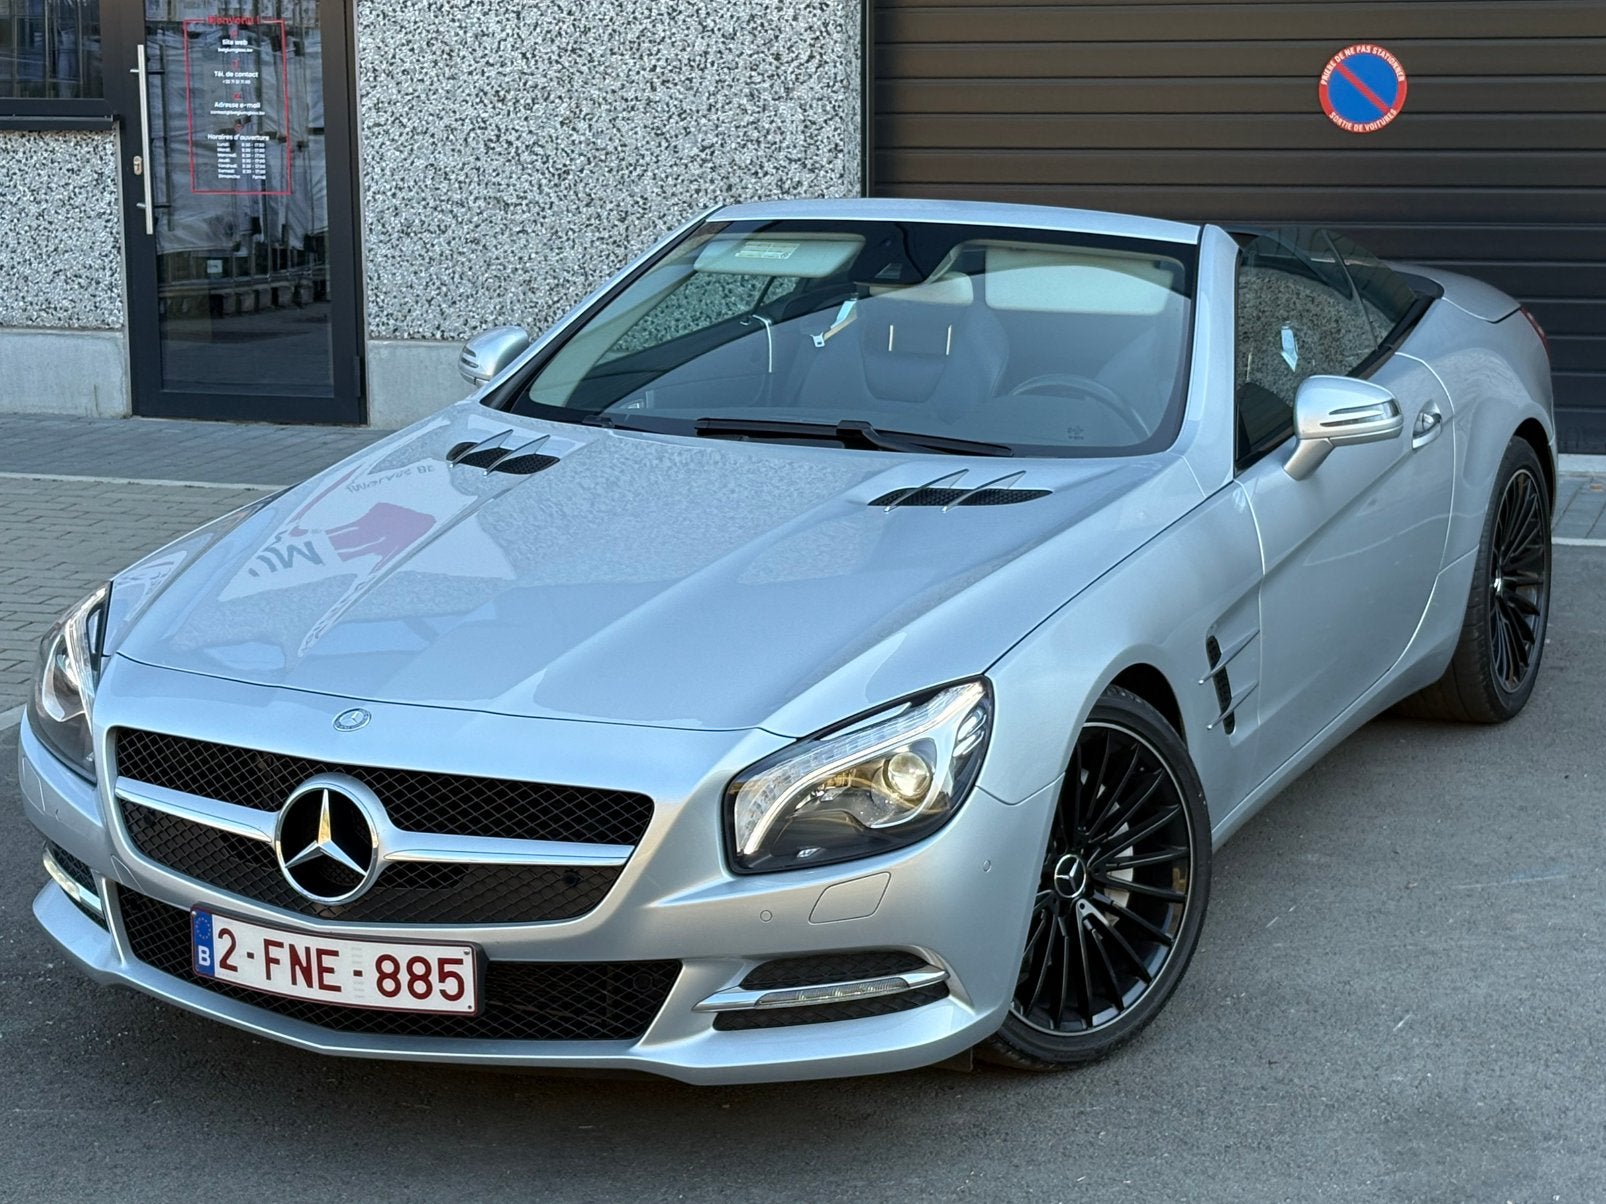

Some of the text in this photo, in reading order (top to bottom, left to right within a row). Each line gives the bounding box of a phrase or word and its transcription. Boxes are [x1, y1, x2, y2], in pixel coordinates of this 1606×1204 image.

[1335, 52, 1345, 63] DE
[1344, 46, 1355, 57] NE
[1356, 45, 1371, 54] PAS
[1372, 46, 1405, 82] STATIONNER
[214, 101, 239, 109] Adresse
[1329, 109, 1397, 132] SORTIE DE VOITURES
[207, 133, 233, 141] Horaires
[198, 945, 211, 966] B
[217, 927, 465, 1002] 2-FNE-885
